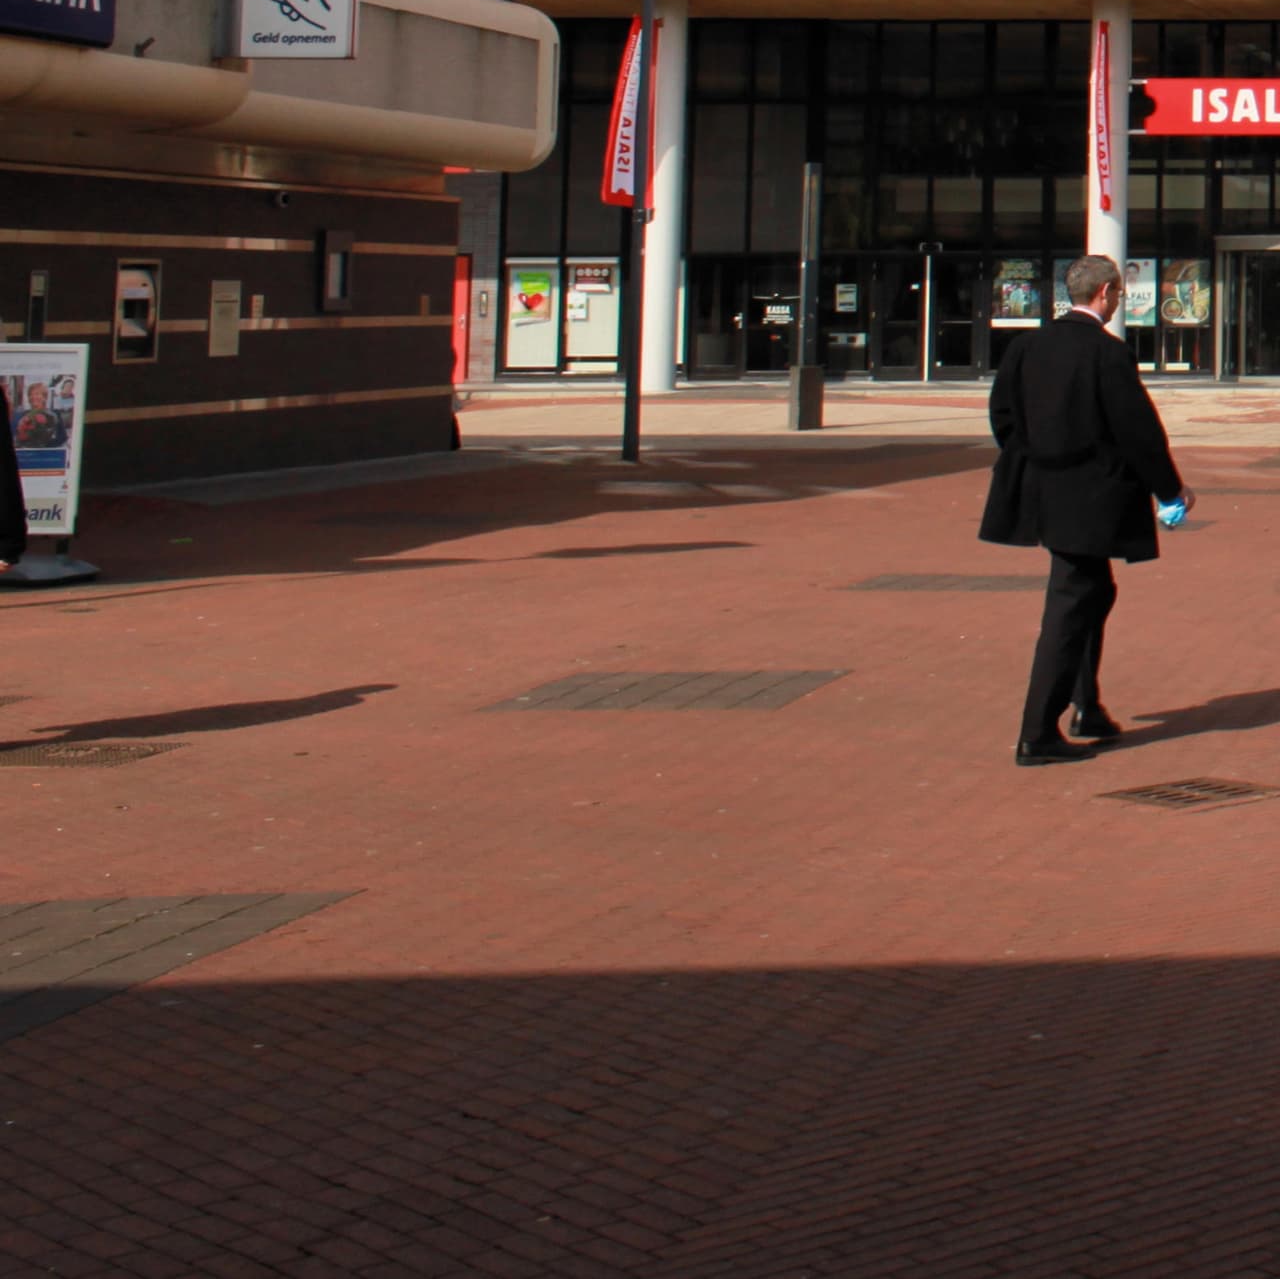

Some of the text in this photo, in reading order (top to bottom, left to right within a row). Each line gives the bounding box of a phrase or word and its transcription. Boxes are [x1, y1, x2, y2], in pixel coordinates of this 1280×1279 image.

[252, 31, 337, 46] Geld opnemen
[25, 503, 63, 521] ank
